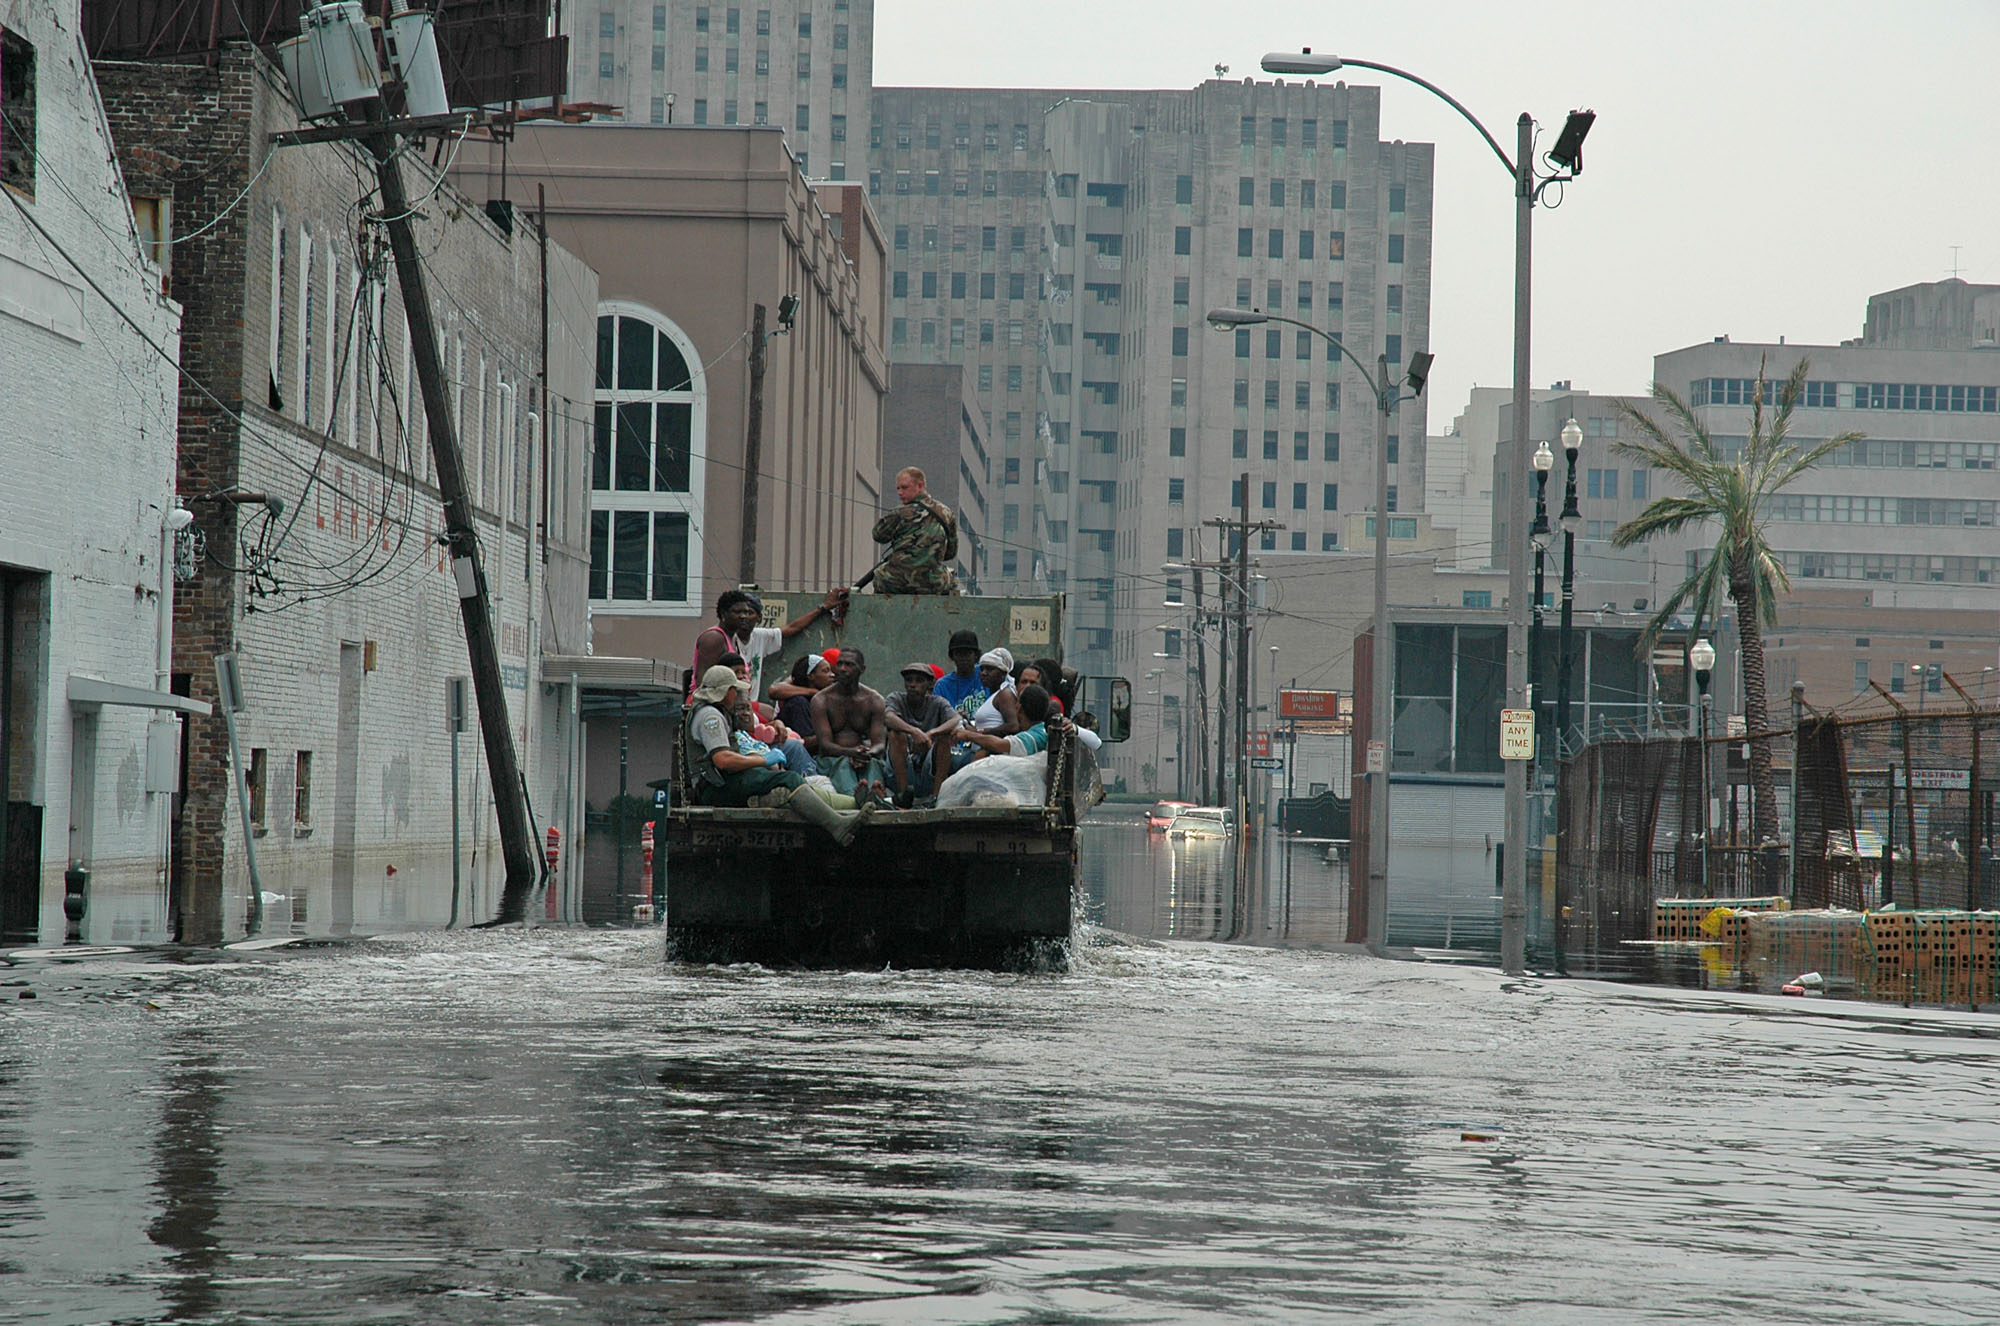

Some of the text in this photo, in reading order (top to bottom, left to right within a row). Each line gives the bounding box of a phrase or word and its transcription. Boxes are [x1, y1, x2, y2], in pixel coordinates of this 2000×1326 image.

[1015, 619, 1046, 631] B 93
[1508, 727, 1527, 735] ANY
[1507, 739, 1529, 748] TIME
[657, 790, 666, 802] P
